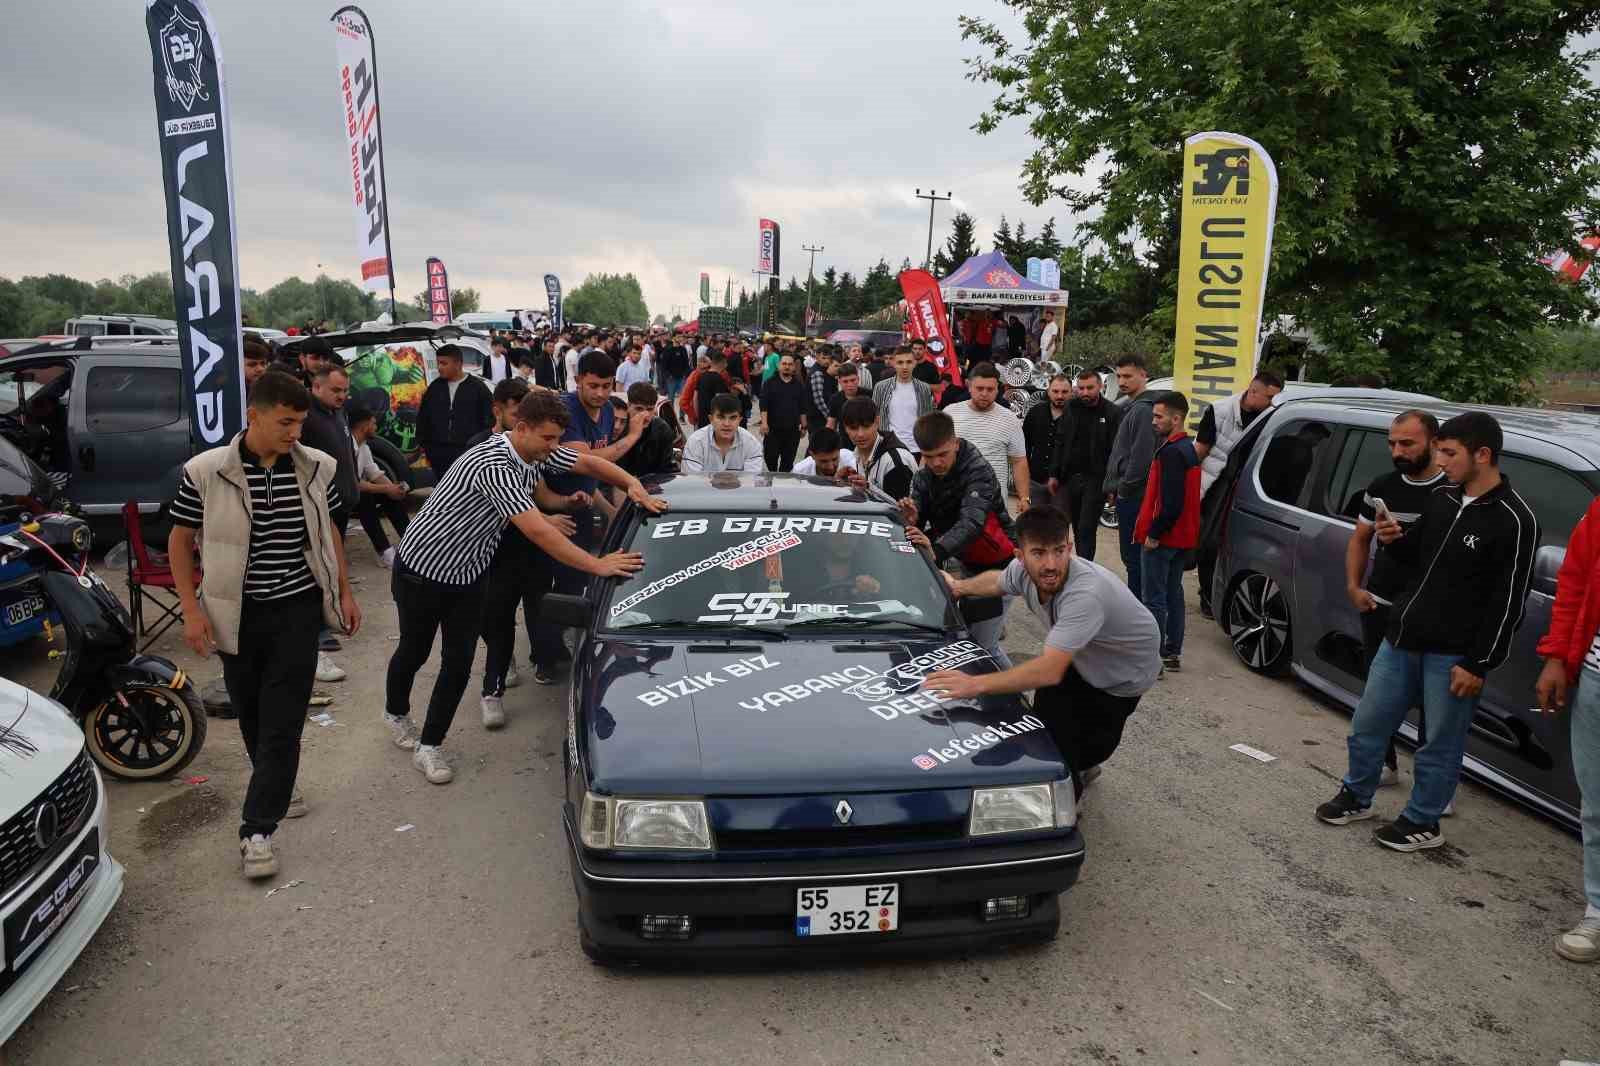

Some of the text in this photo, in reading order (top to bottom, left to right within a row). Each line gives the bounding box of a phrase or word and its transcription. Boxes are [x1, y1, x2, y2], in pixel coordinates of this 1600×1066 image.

[652, 517, 893, 539] EB GARAGE
[899, 641, 977, 674] SOUND
[636, 671, 728, 707] BİZİK
[737, 664, 878, 712] YABANCI
[801, 886, 896, 910] 55 EZ
[829, 910, 870, 931] 352
